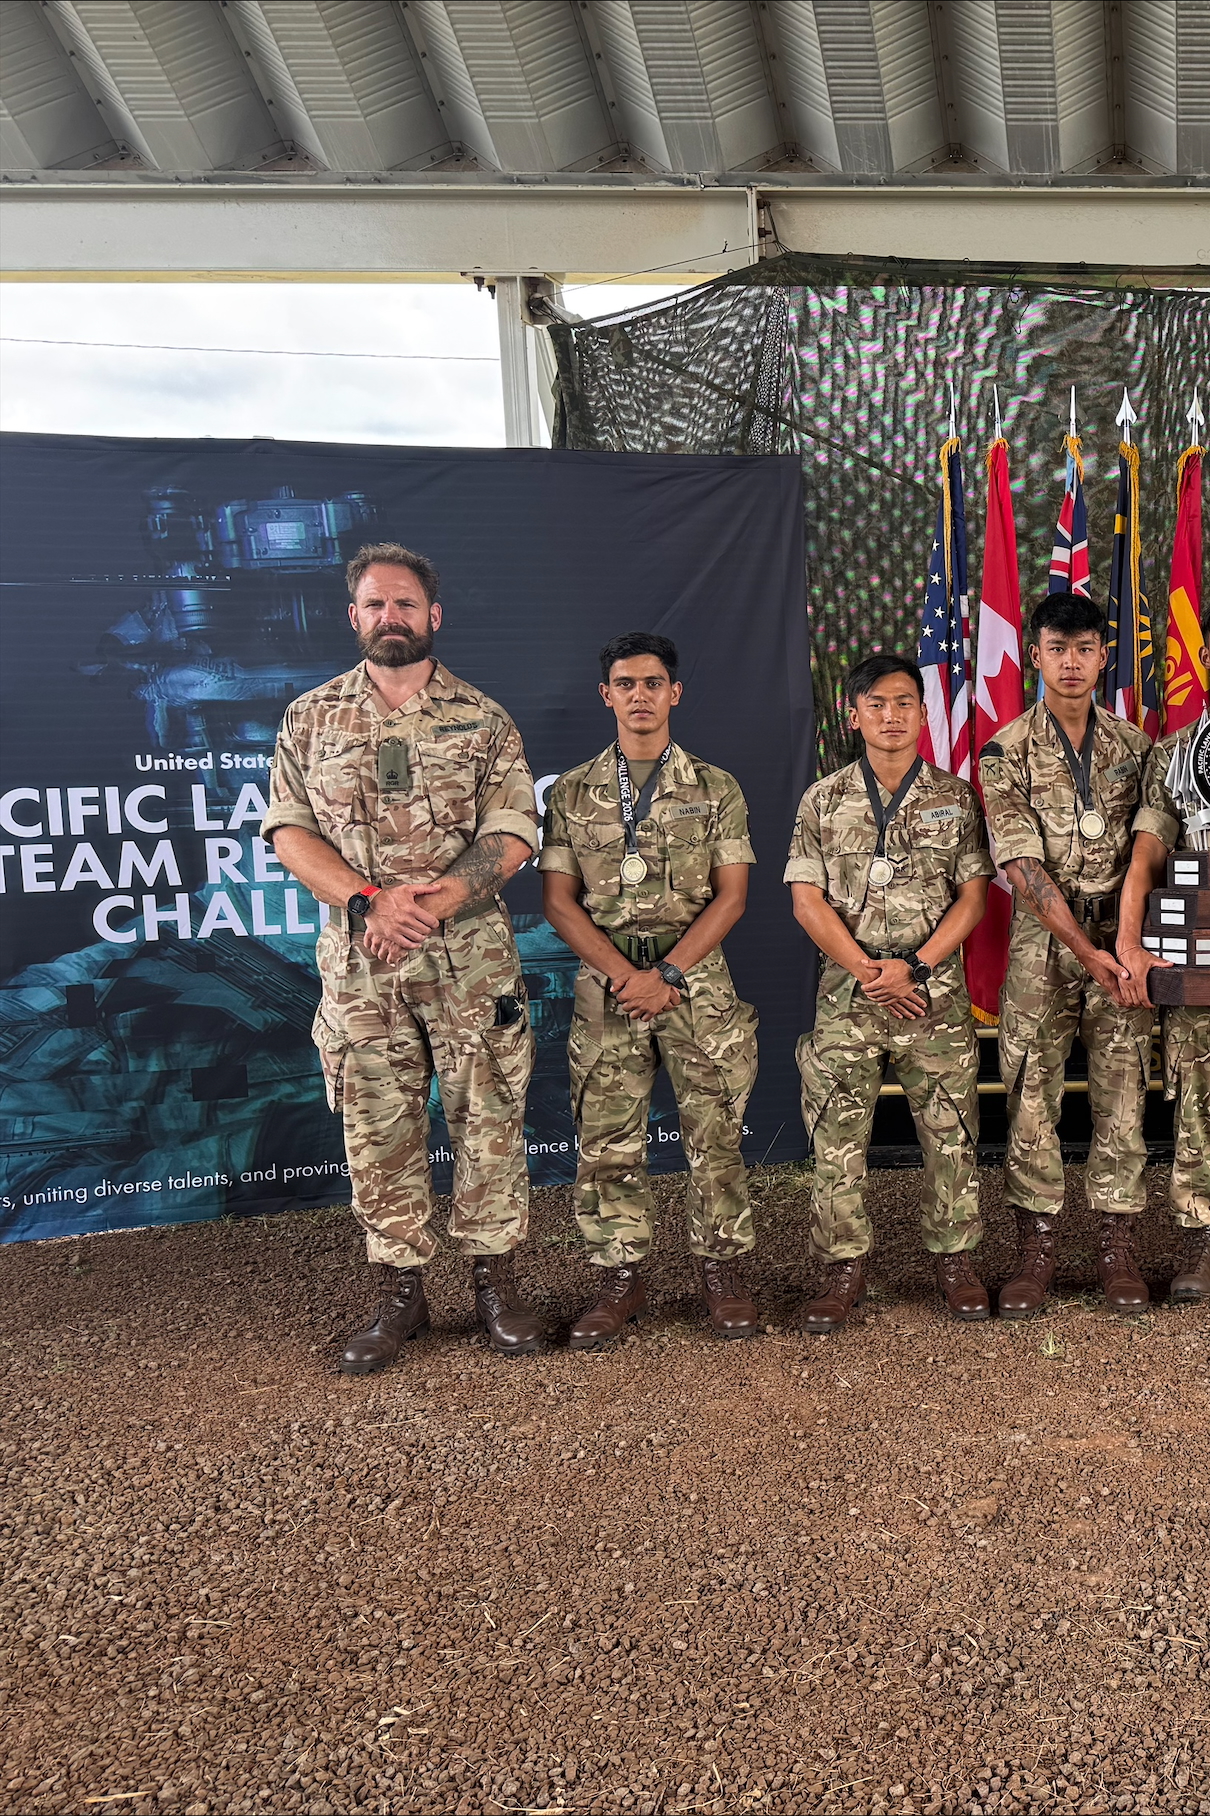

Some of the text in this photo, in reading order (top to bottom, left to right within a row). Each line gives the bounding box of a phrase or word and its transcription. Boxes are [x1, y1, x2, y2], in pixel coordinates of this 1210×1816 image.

[438, 722, 478, 732] REYNOLDS
[135, 752, 274, 771] United State
[0, 783, 270, 838] CIFIC LA
[622, 801, 633, 822] 2026
[679, 806, 701, 816] NABIN
[931, 808, 953, 819] ABIRAL
[93, 888, 329, 944] CHALL
[23, 1186, 88, 1205] uniting
[94, 1179, 162, 1197] diverse
[167, 1171, 233, 1189] talents,
[240, 1164, 277, 1183] and
[283, 1159, 351, 1183] proving
[523, 1139, 569, 1155] lence
